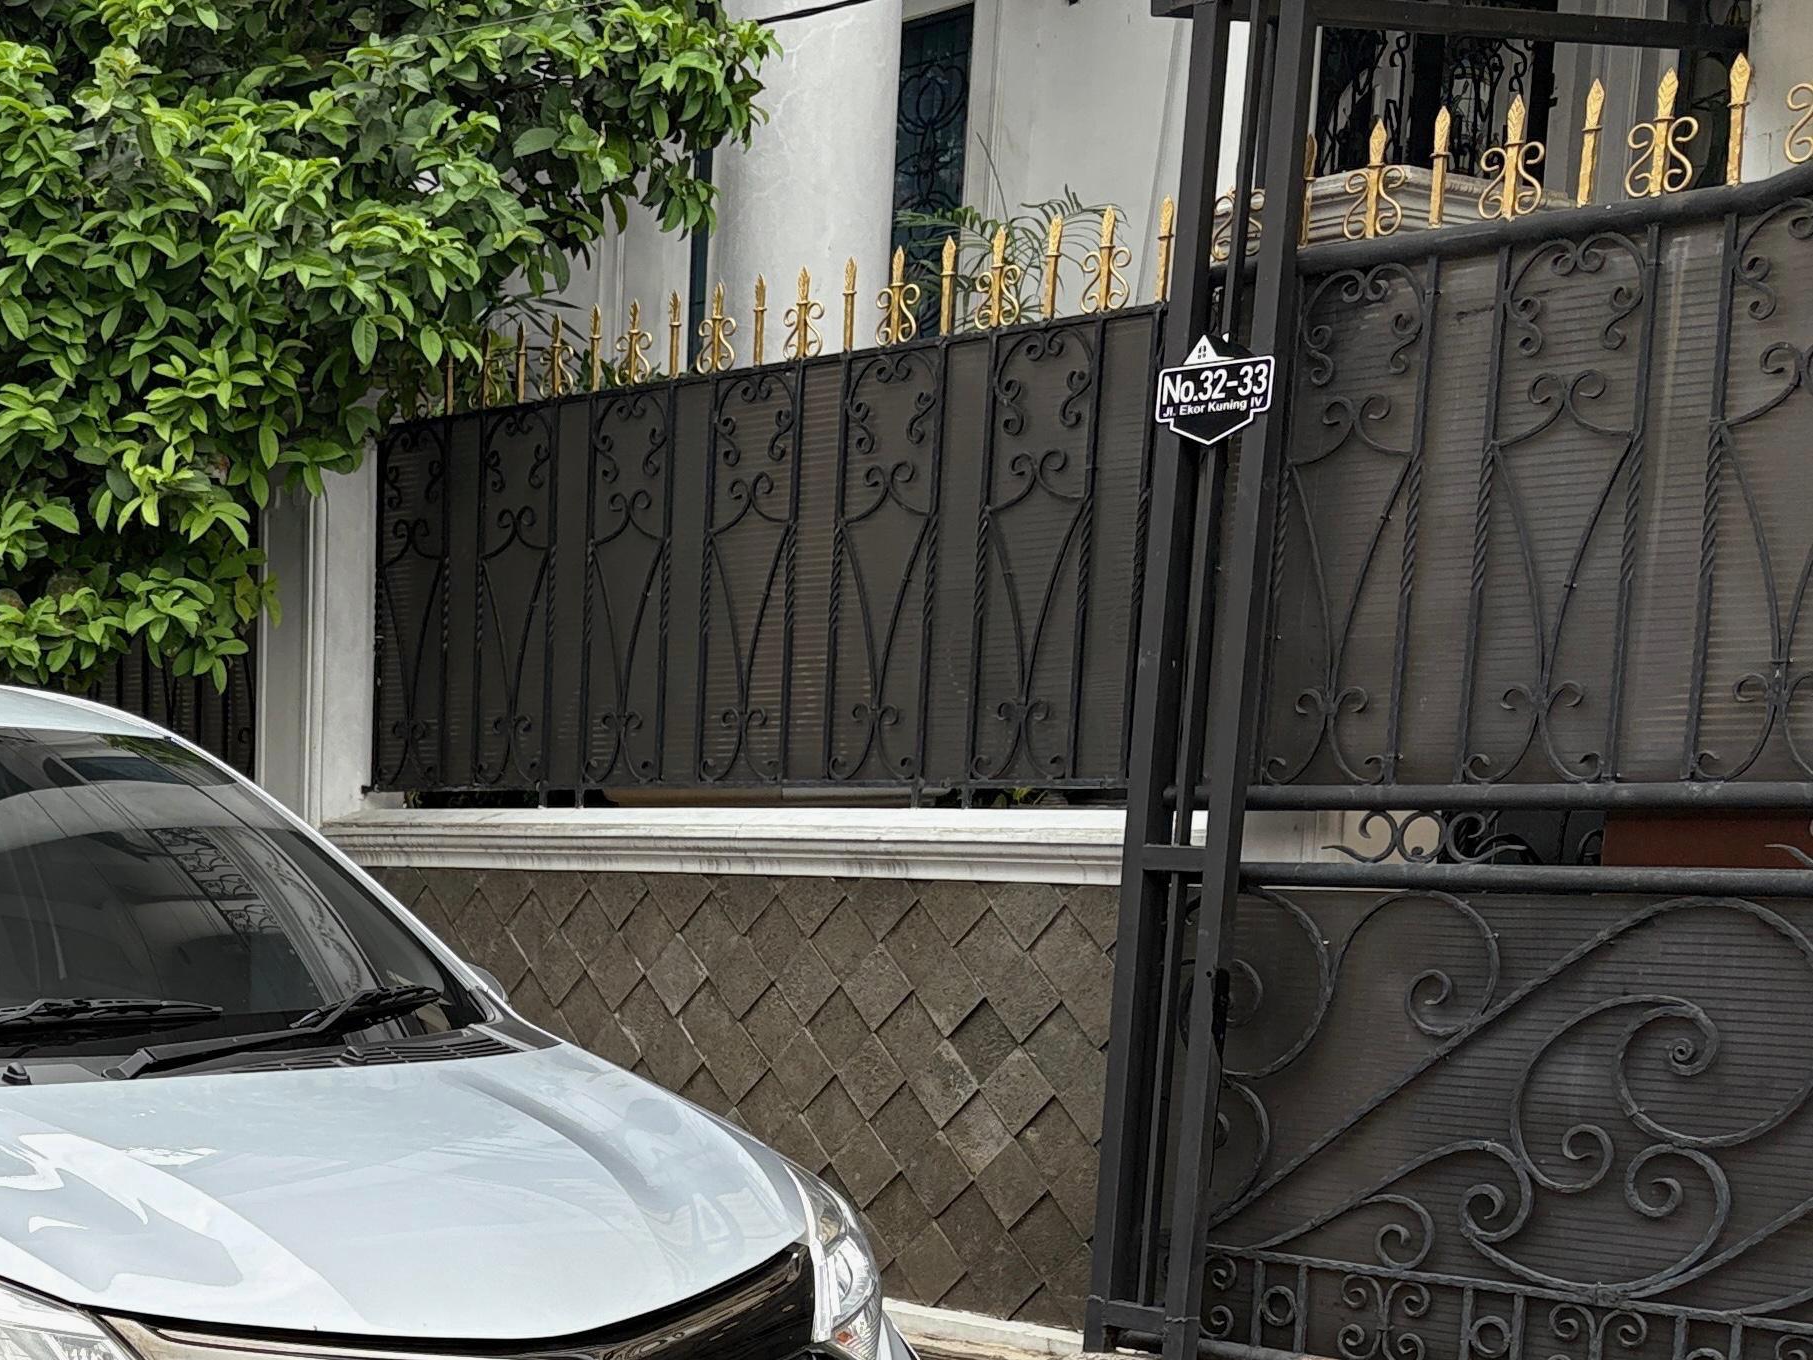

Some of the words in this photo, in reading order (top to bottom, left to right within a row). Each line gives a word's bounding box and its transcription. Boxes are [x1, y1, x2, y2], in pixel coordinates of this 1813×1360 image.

[1162, 363, 1269, 405] No.32-33
[1162, 406, 1177, 418] Jl.
[1179, 404, 1206, 416] Ekor
[1208, 398, 1248, 412] Kuning
[1250, 395, 1264, 408] IV
